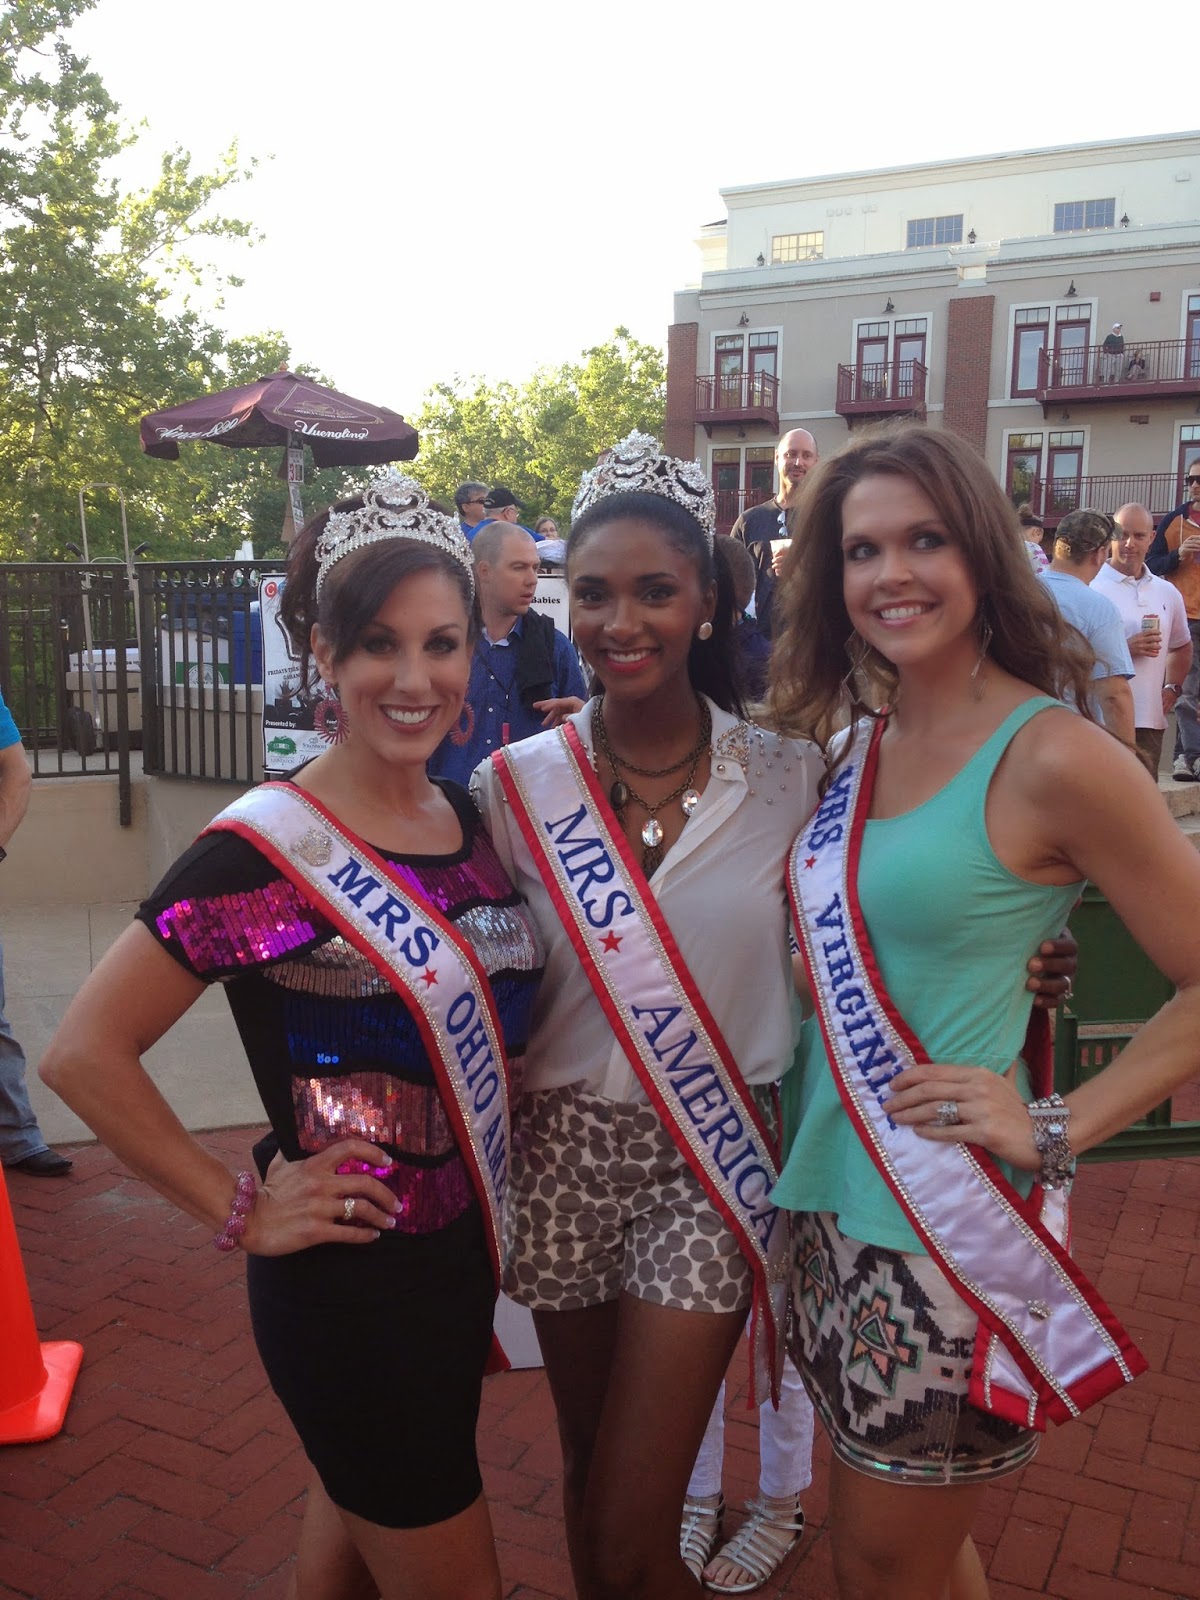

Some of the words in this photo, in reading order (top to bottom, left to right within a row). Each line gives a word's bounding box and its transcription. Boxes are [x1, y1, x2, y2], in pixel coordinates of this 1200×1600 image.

[294, 420, 369, 439] Yuengling
[265, 719, 288, 727] Presented
[808, 765, 853, 851] MRS
[327, 857, 441, 967] MRS
[446, 991, 499, 1114] OHIO
[544, 803, 636, 929] MRS
[631, 1004, 779, 1253] AMERICA
[815, 893, 904, 1131] VIRGINI
